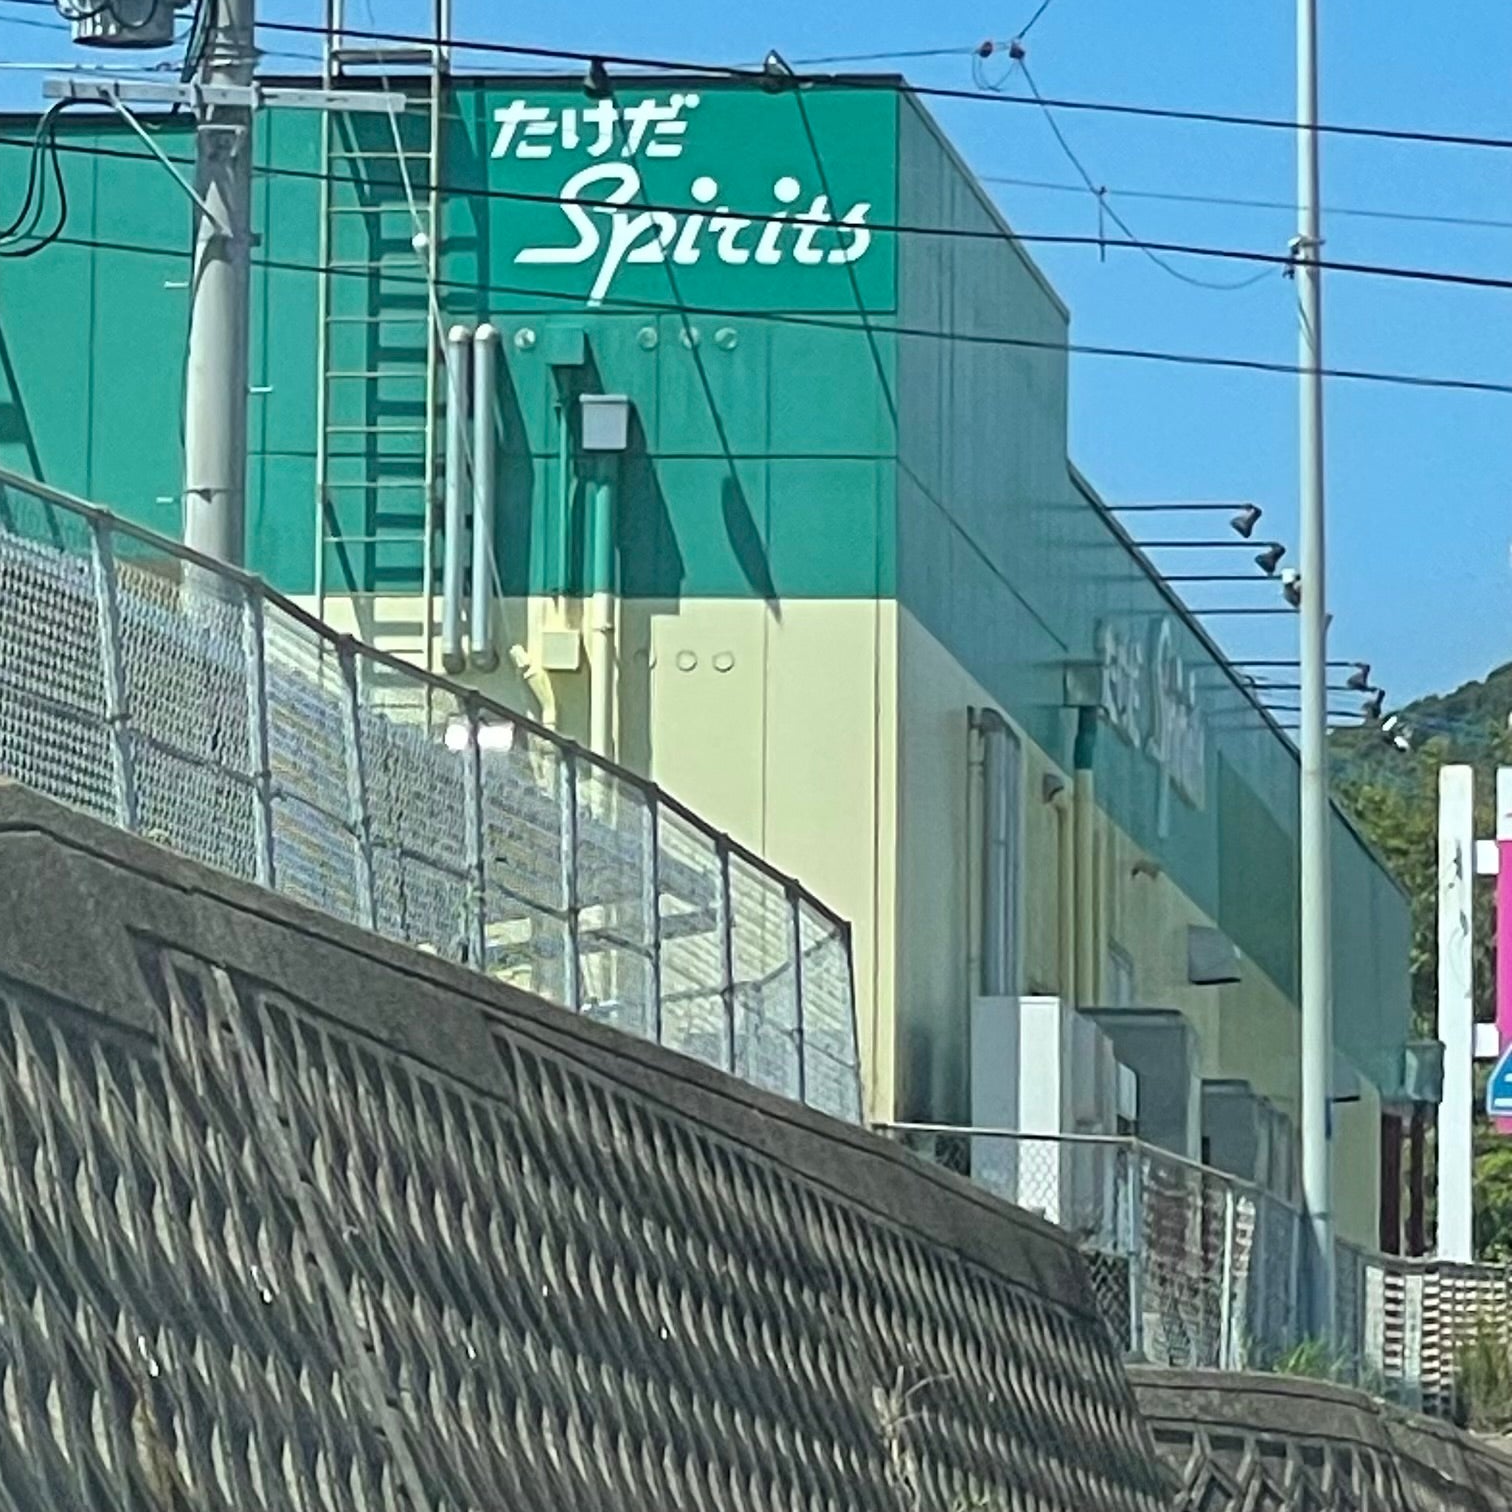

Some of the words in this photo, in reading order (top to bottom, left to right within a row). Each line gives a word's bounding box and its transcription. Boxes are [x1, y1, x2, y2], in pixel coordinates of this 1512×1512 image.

[490, 93, 700, 159] たけだ
[513, 161, 872, 307] Spirits
